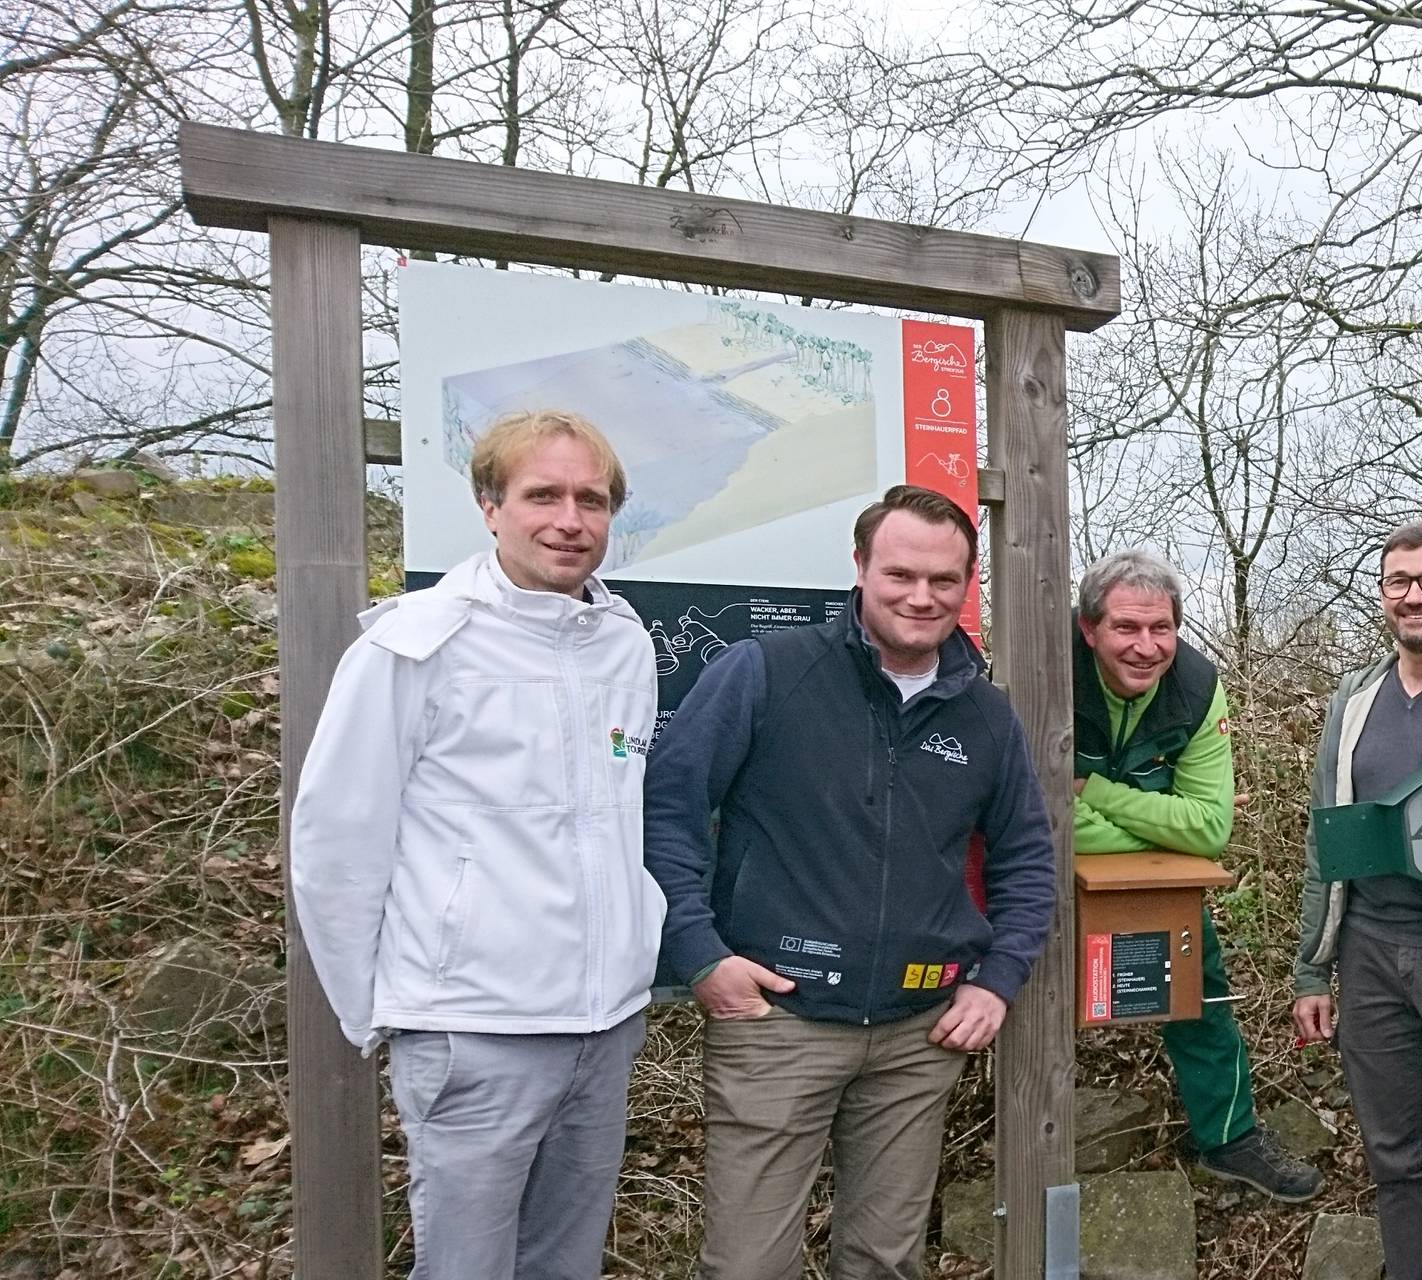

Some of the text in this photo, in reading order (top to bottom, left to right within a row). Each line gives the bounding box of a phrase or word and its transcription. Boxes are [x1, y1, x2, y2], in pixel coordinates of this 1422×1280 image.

[911, 350, 962, 372] Bergische
[931, 388, 951, 417] 8
[915, 423, 967, 434] STEINHAUERPFAD
[750, 606, 779, 614] WACKER,
[919, 741, 968, 761] Das Bergische
